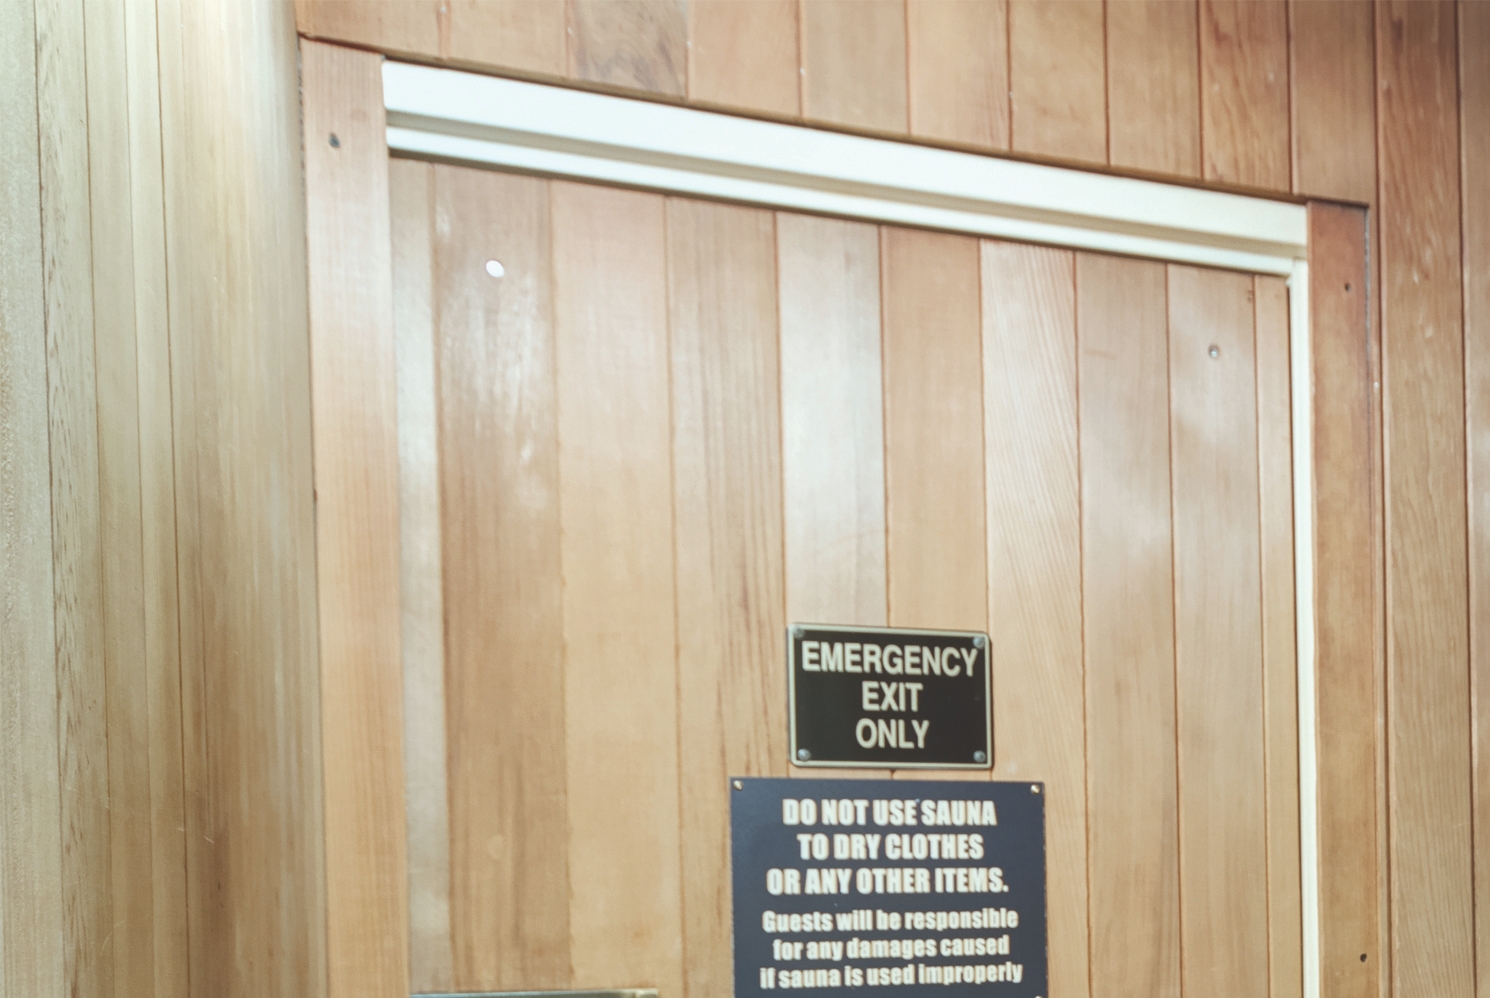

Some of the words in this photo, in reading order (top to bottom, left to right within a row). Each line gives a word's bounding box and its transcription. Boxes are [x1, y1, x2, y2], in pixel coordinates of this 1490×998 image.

[802, 640, 979, 677] EMERGENCY
[861, 681, 924, 712] EXIT
[855, 718, 930, 749] ONLY
[782, 798, 817, 826] DO
[821, 798, 869, 826] NOT
[872, 799, 918, 826] USE
[920, 799, 997, 827] SAUNA
[797, 833, 829, 861] TO
[833, 833, 882, 861] DRY
[885, 833, 984, 860] CLOTHES
[766, 868, 801, 896] OR
[805, 868, 852, 895] ANY
[856, 867, 930, 894] OTHER
[935, 867, 1009, 894] ITEMS.
[762, 910, 833, 933] Guests
[836, 909, 873, 931] will
[876, 909, 902, 931] be
[904, 907, 1019, 932] responsible
[773, 939, 804, 961] for
[806, 940, 844, 962] any
[847, 937, 937, 961] damages
[940, 935, 1010, 957] caused
[778, 967, 841, 988] sauna
[844, 966, 864, 987] is
[867, 964, 915, 986] used
[918, 962, 1023, 986] improperly
